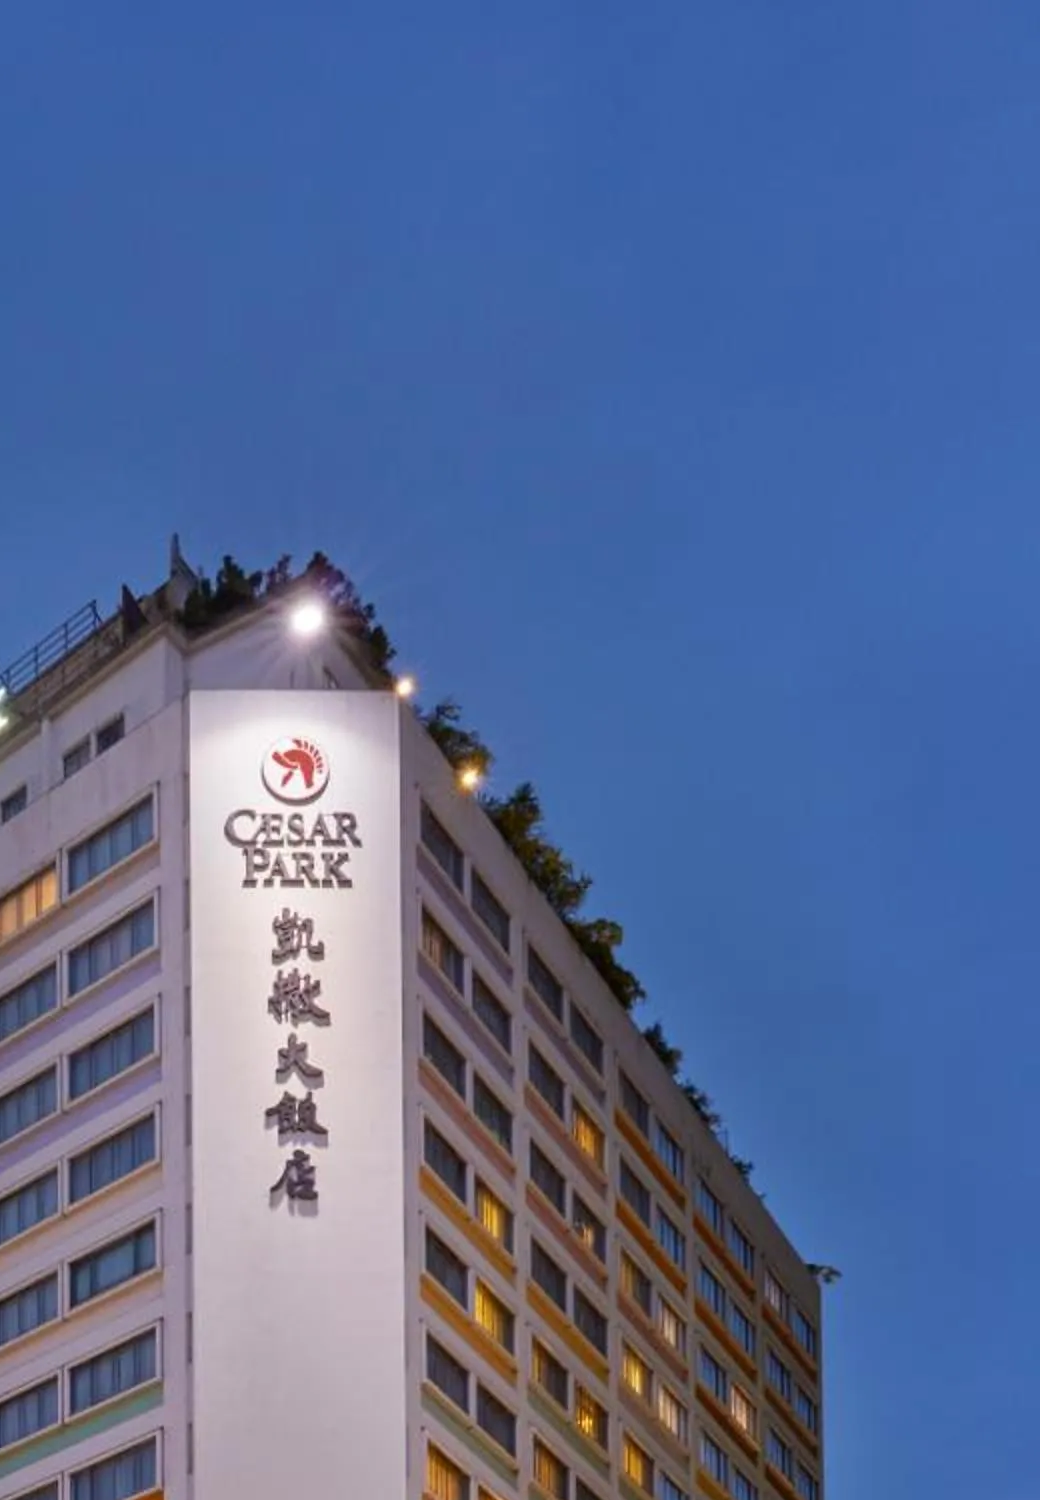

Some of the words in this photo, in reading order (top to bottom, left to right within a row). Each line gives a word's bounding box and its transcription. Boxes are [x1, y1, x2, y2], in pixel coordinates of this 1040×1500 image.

[241, 848, 352, 888] PARK
[265, 907, 331, 1208] 凱撒大飯店
